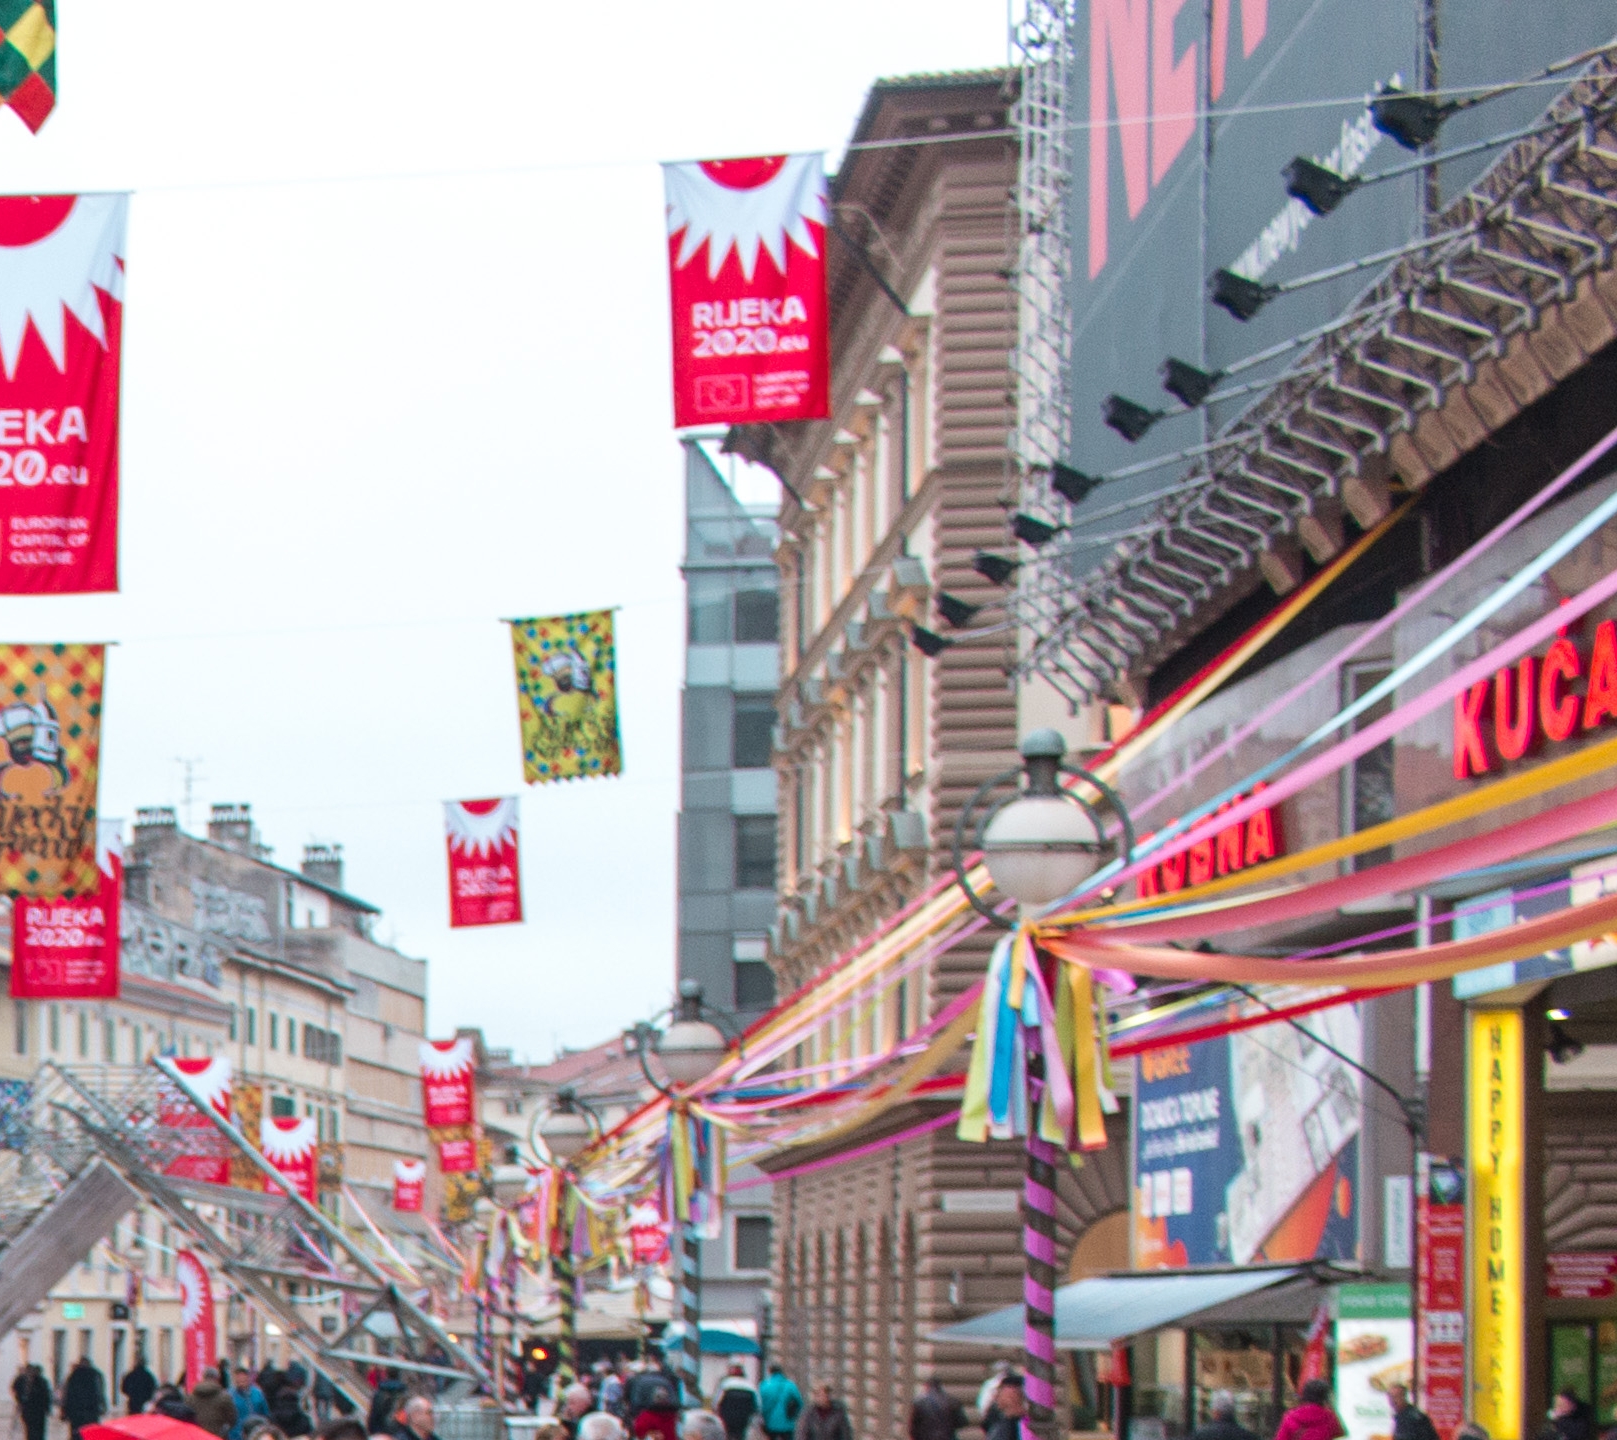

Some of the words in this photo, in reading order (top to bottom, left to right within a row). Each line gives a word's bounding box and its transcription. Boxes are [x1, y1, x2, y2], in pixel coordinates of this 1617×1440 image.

[1088, 0, 1266, 281] NE
[691, 295, 808, 329] RIJEKA
[691, 326, 810, 358] 2020.eu
[25, 907, 105, 927] RIJEKA
[1489, 1025, 1504, 1177] HAPPY
[1487, 1197, 1505, 1316] HOME
